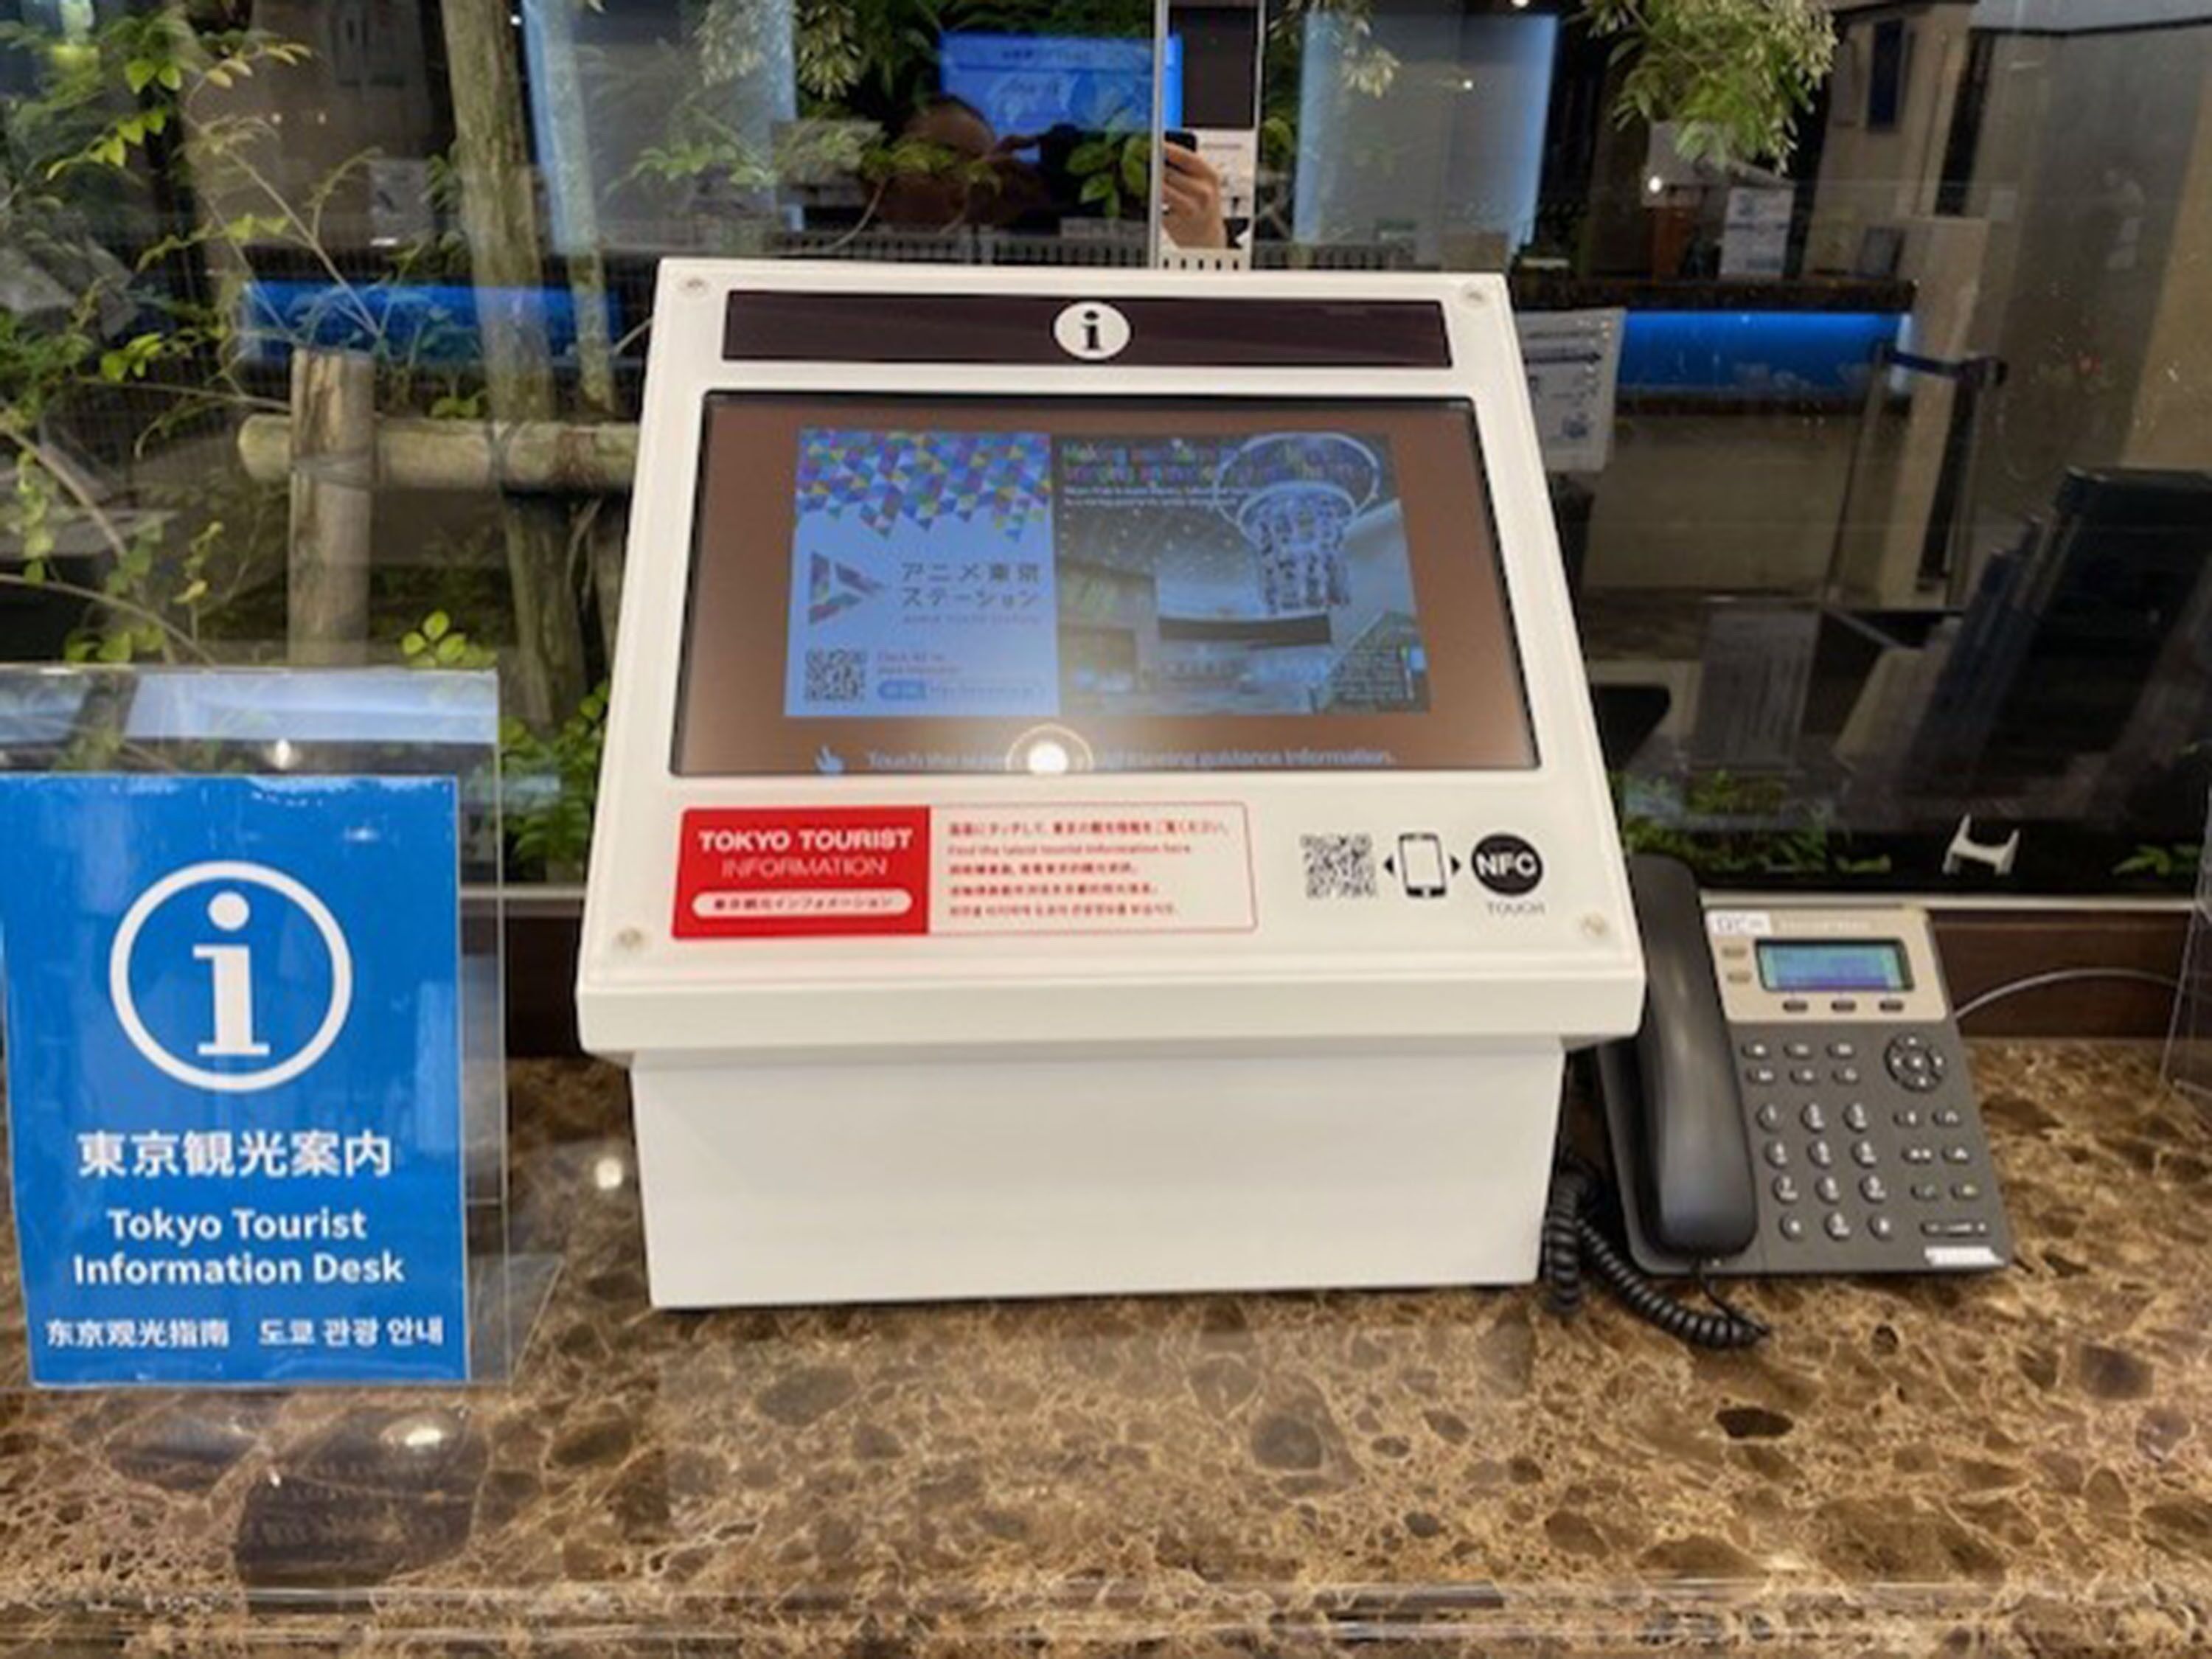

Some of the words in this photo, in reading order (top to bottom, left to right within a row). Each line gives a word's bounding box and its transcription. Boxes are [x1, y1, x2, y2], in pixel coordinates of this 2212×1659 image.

[698, 829, 792, 852] TOKYO
[799, 827, 914, 851] TOURIST
[720, 855, 889, 878] INFORMATION
[1475, 850, 1538, 877] NFC
[1486, 900, 1545, 917] TOUCH
[76, 1130, 392, 1179] 東京観光案内
[106, 1207, 223, 1248] Tokyo
[232, 1207, 367, 1239] Tourist
[74, 1251, 303, 1285] Information
[313, 1248, 405, 1284] Desk
[45, 1318, 230, 1349] 东京观光指南
[322, 1315, 380, 1348] 관광
[386, 1314, 445, 1347] 안내
